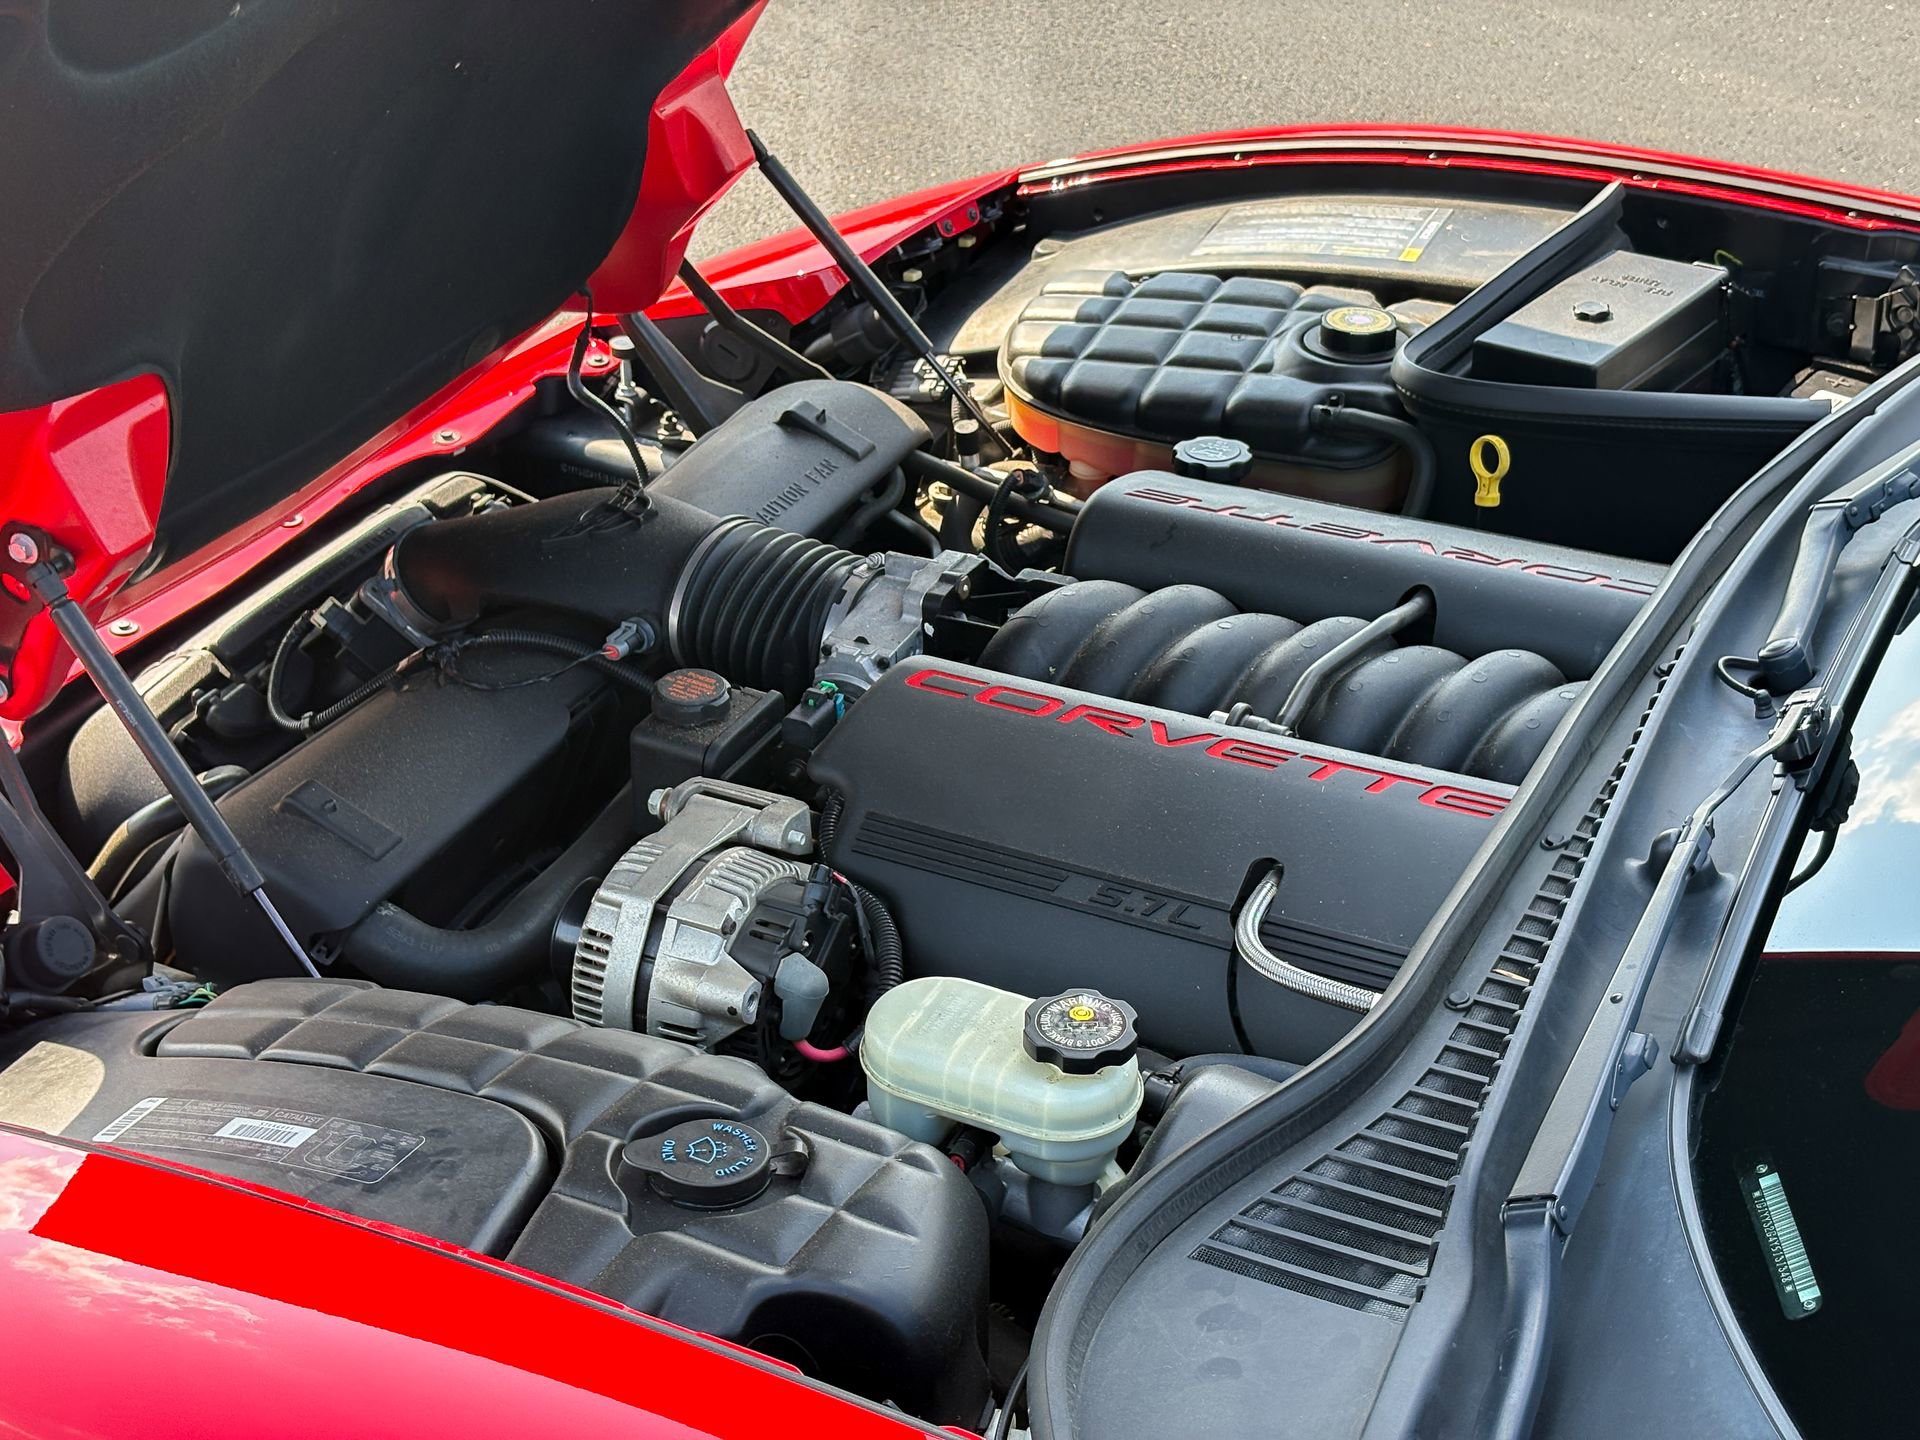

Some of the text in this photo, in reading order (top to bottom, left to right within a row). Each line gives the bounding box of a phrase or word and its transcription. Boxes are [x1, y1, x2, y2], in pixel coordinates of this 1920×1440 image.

[756, 458, 839, 525] AUTION FAN
[904, 668, 1513, 819] CORVETTE
[1088, 882, 1201, 929] 5.7L
[1046, 995, 1111, 1013] WARNING
[1040, 1012, 1051, 1031] FLUID
[1110, 1012, 1123, 1026] USE
[1046, 1030, 1073, 1046] BRAKE
[1085, 1037, 1105, 1047] DOT
[274, 1111, 325, 1124] CATALYST
[662, 1139, 677, 1161] ONLY
[712, 1123, 757, 1176] WASHER FLUID
